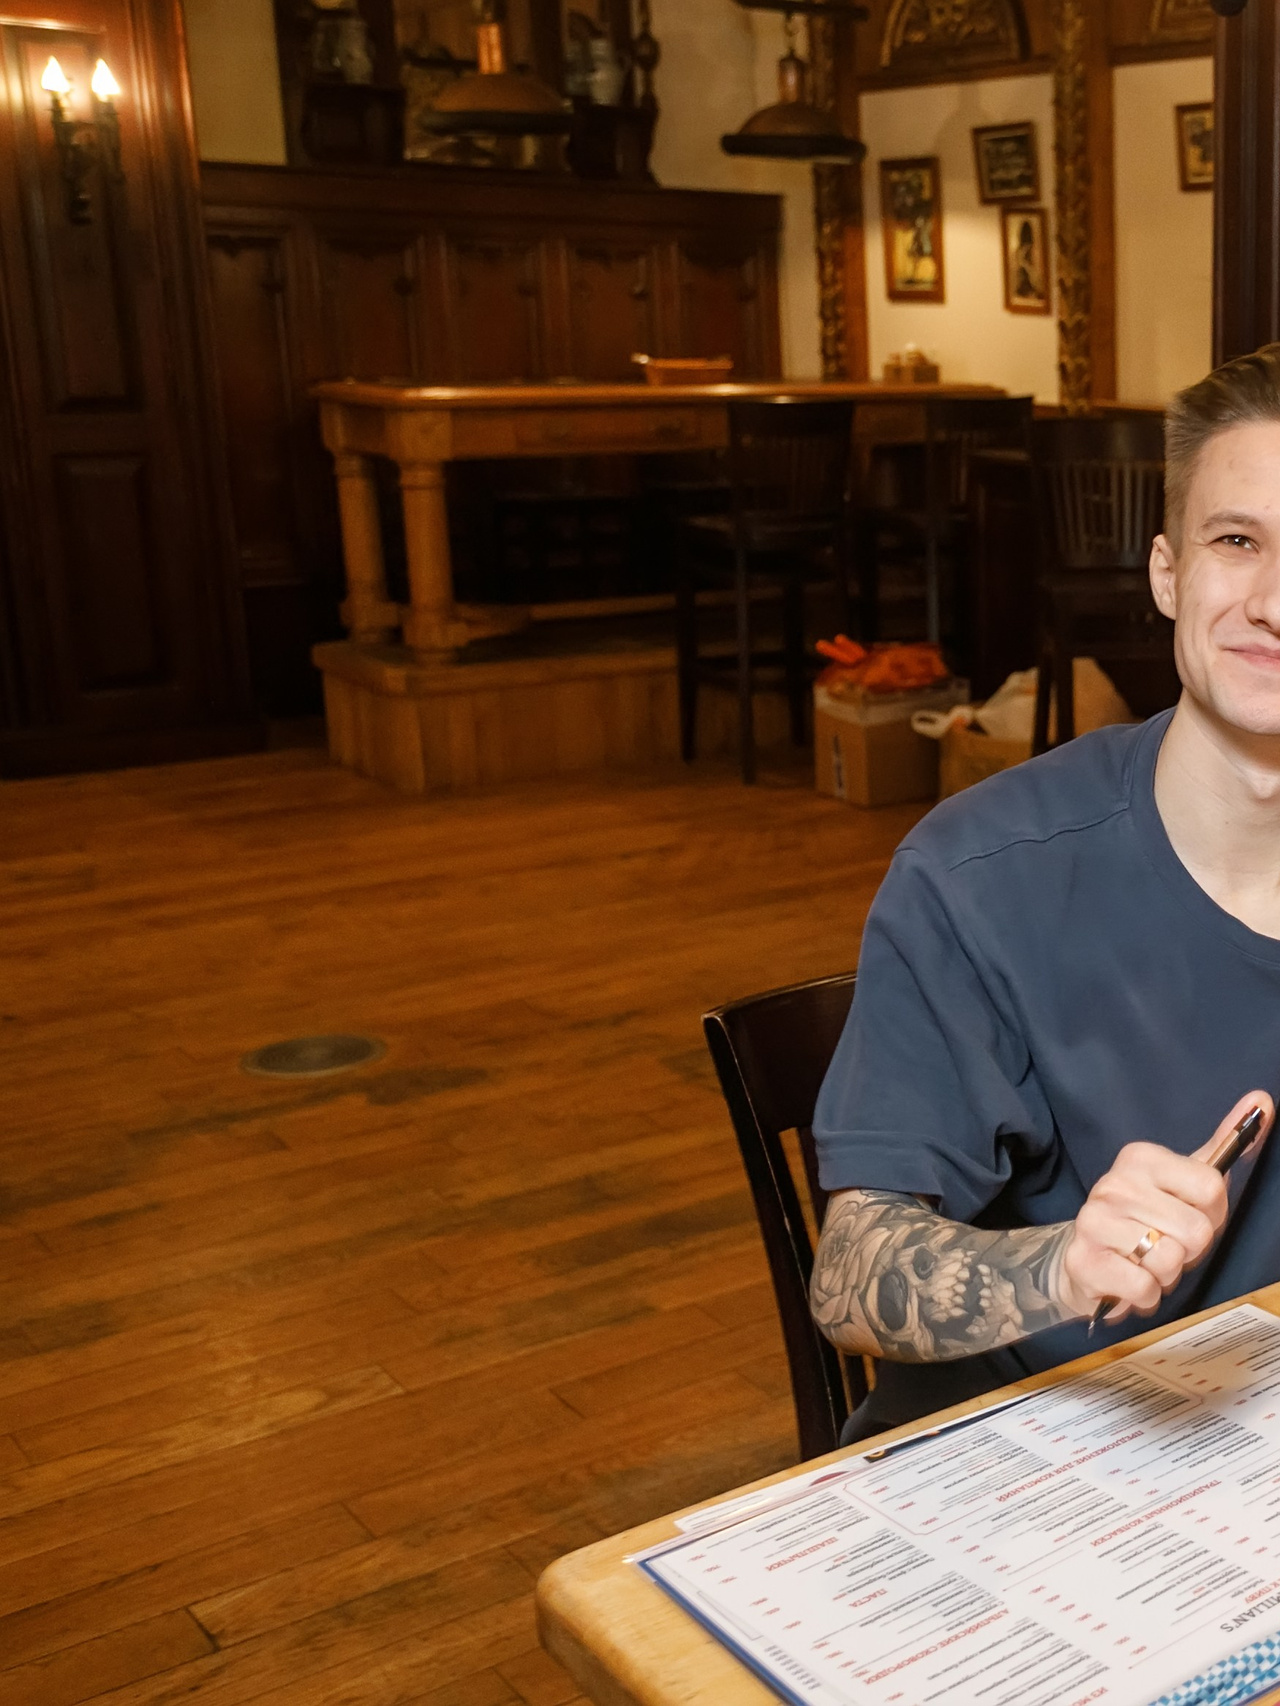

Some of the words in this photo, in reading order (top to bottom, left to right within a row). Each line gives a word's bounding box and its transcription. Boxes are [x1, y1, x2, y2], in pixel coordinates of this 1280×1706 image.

[1071, 1430, 1145, 1464] ПРЕДЛОЖЕНИЕ
[1052, 1462, 1075, 1474] ДЛЯ
[992, 1472, 1056, 1502] КОМПАНИЙ
[1139, 1479, 1223, 1520] ТРАДИЦИОННЫЕ
[1088, 1518, 1144, 1546] КОЛБАСКИ
[763, 1536, 839, 1571] ШАШЛЫЧКИ
[847, 1588, 887, 1608] ПАСТА
[1240, 1585, 1273, 1603] ПИВУ
[935, 1608, 1012, 1647] АЛЬПИЙСКИЕ
[862, 1645, 939, 1685] СКОВОРОДКИ
[1088, 1686, 1108, 1698] ИЗ
